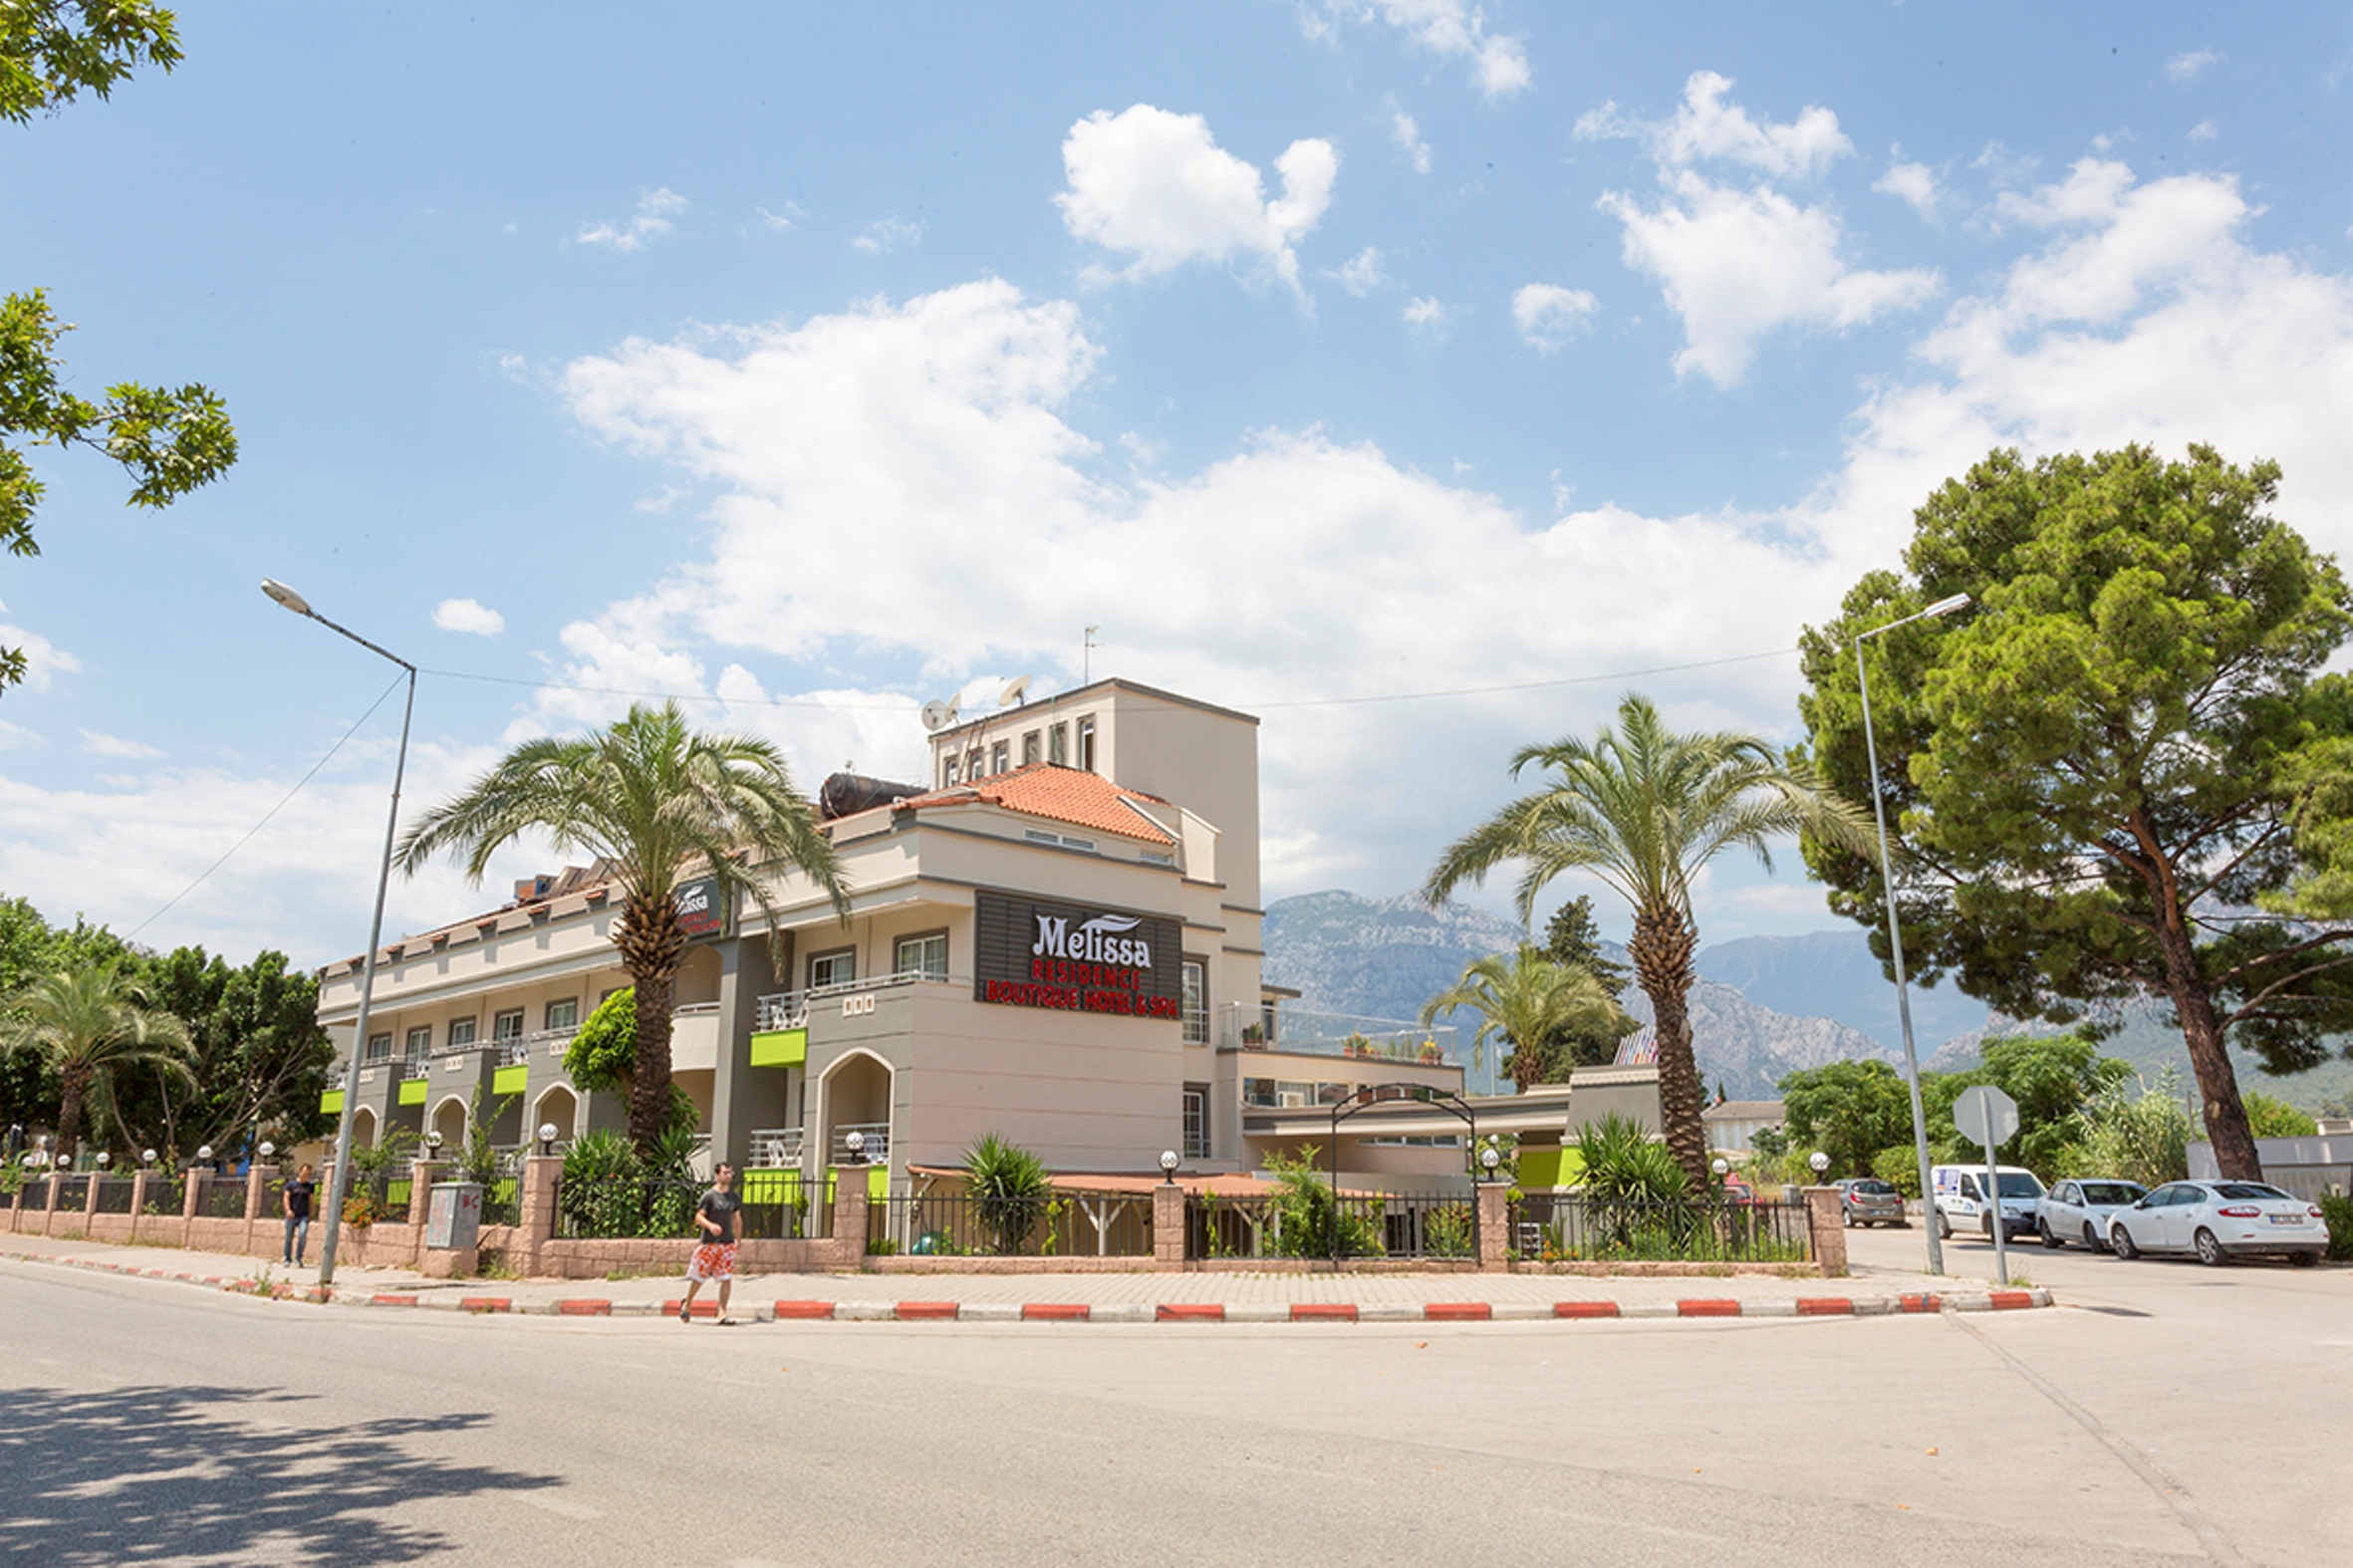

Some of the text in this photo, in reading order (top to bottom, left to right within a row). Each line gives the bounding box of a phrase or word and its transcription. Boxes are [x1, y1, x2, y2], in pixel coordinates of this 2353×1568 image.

[1032, 914, 1152, 968] Melissa
[1032, 958, 1141, 990] RESIDENCE
[987, 979, 1178, 1017] BOUTIQUE HOTEL & SPA
